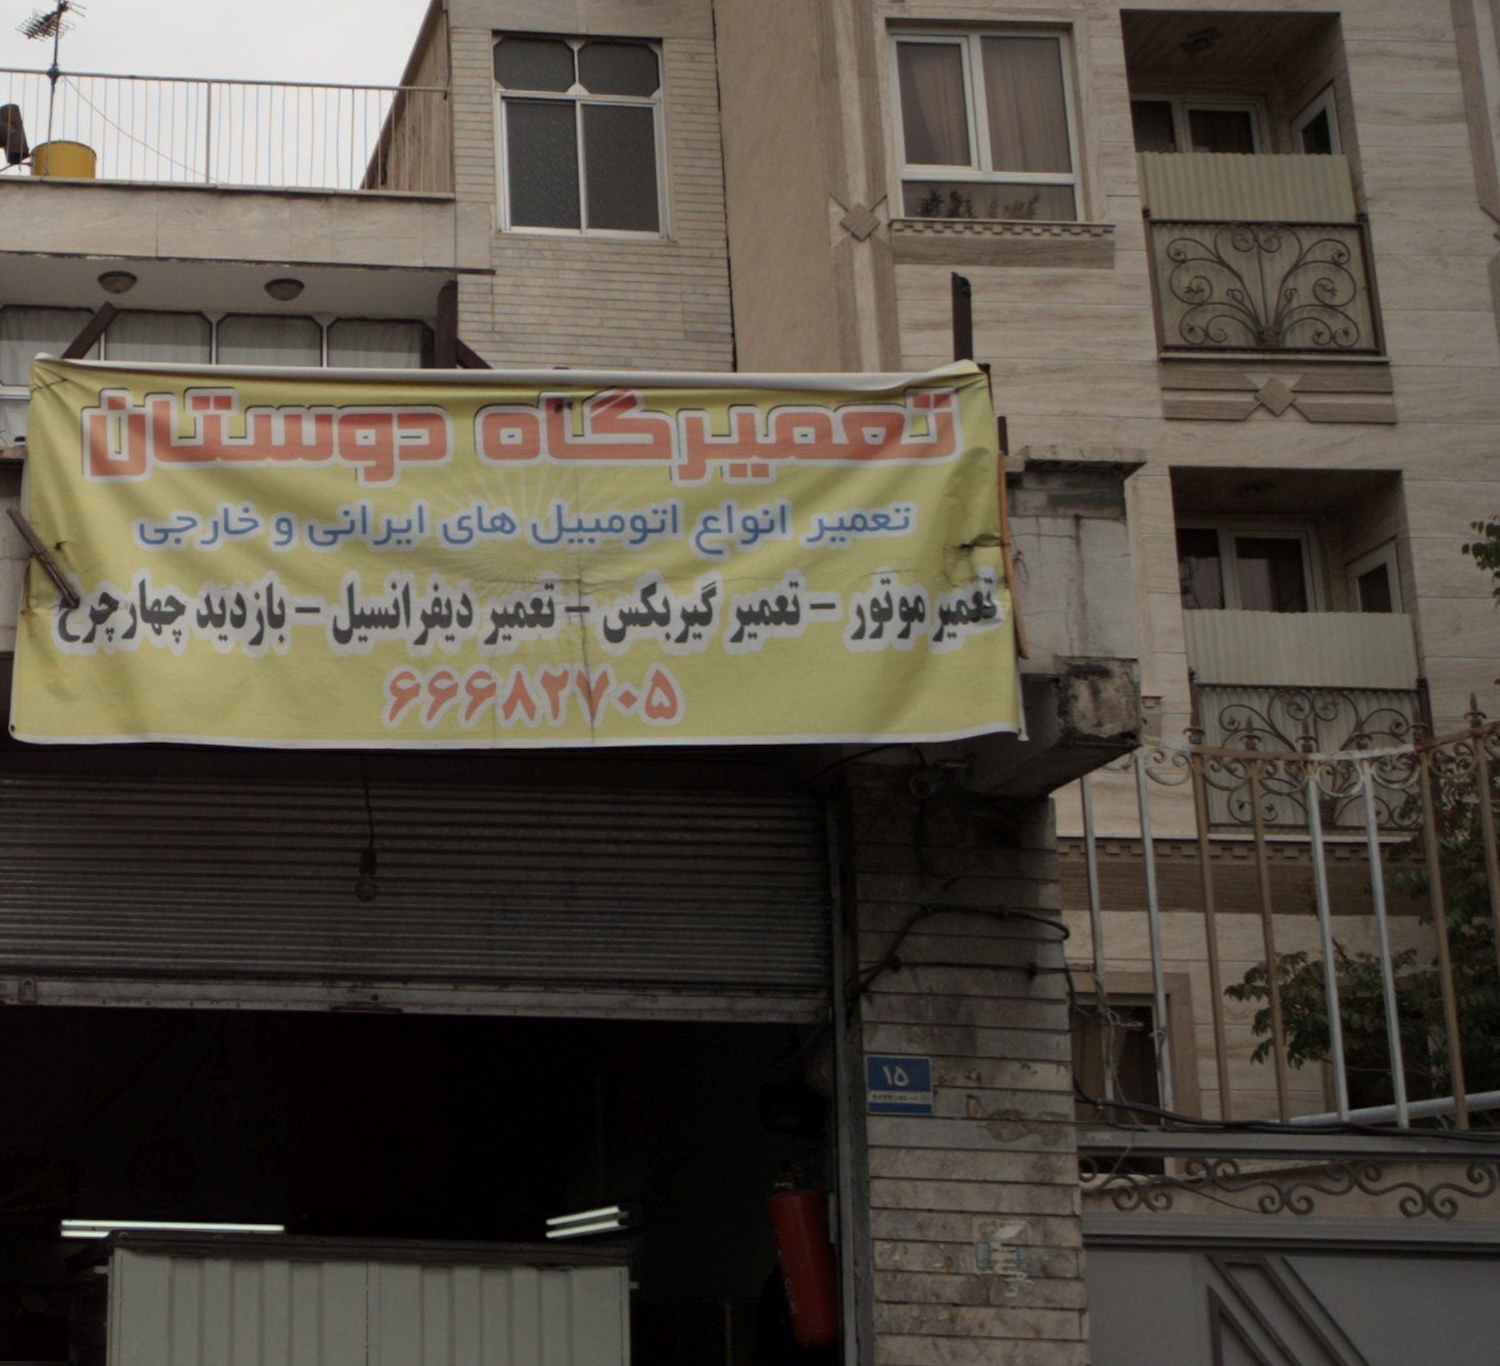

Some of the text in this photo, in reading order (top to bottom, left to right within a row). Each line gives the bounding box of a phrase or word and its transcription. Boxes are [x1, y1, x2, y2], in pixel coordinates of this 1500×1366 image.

[86, 389, 958, 485] تعمیرگاه دوستان
[138, 503, 912, 555] تعمیر انواع اتومبیل های ایرانی و خارجی
[195, 581, 286, 646] بازدید
[332, 580, 474, 646] دیفرانسیل
[483, 582, 556, 646] تعمیر
[729, 579, 801, 643] تعمیر
[850, 577, 926, 641] موتور
[932, 576, 998, 643] تعمیر
[882, 1065, 909, 1087] ۱۵
